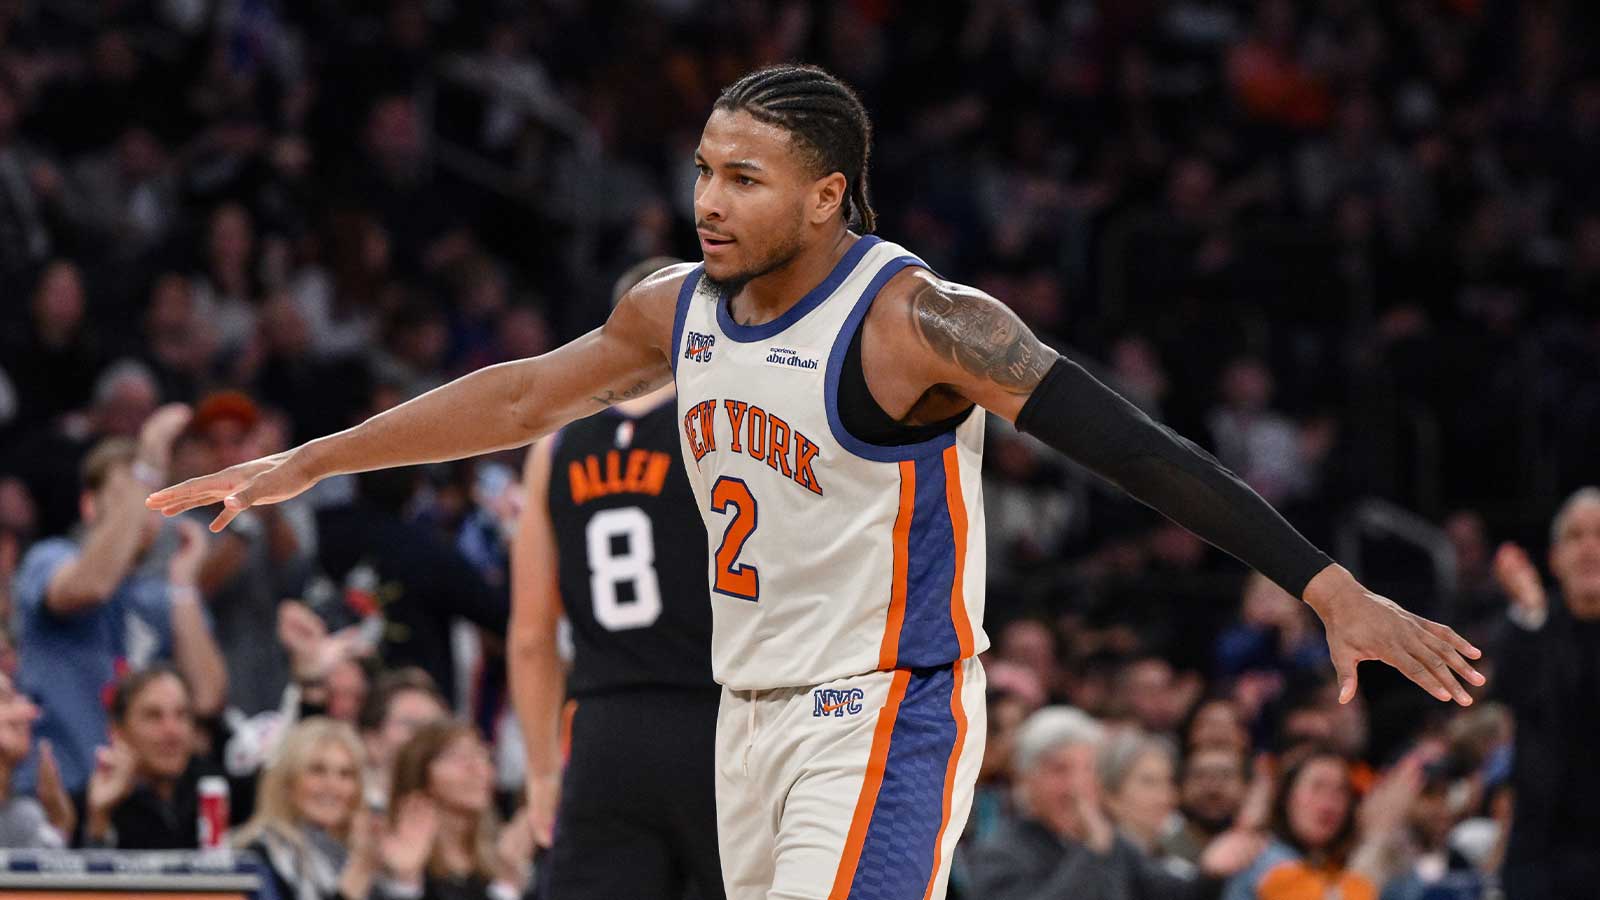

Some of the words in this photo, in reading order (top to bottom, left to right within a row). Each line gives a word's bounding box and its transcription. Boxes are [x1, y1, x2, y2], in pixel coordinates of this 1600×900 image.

[684, 331, 715, 363] NYC
[766, 353, 785, 364] abu
[787, 357, 819, 370] dhabi
[770, 347, 797, 355] experience
[724, 399, 823, 496] YORK
[568, 449, 671, 506] ALLEN
[710, 475, 759, 602] 2
[585, 507, 663, 631] 8
[813, 687, 864, 717] NYC
